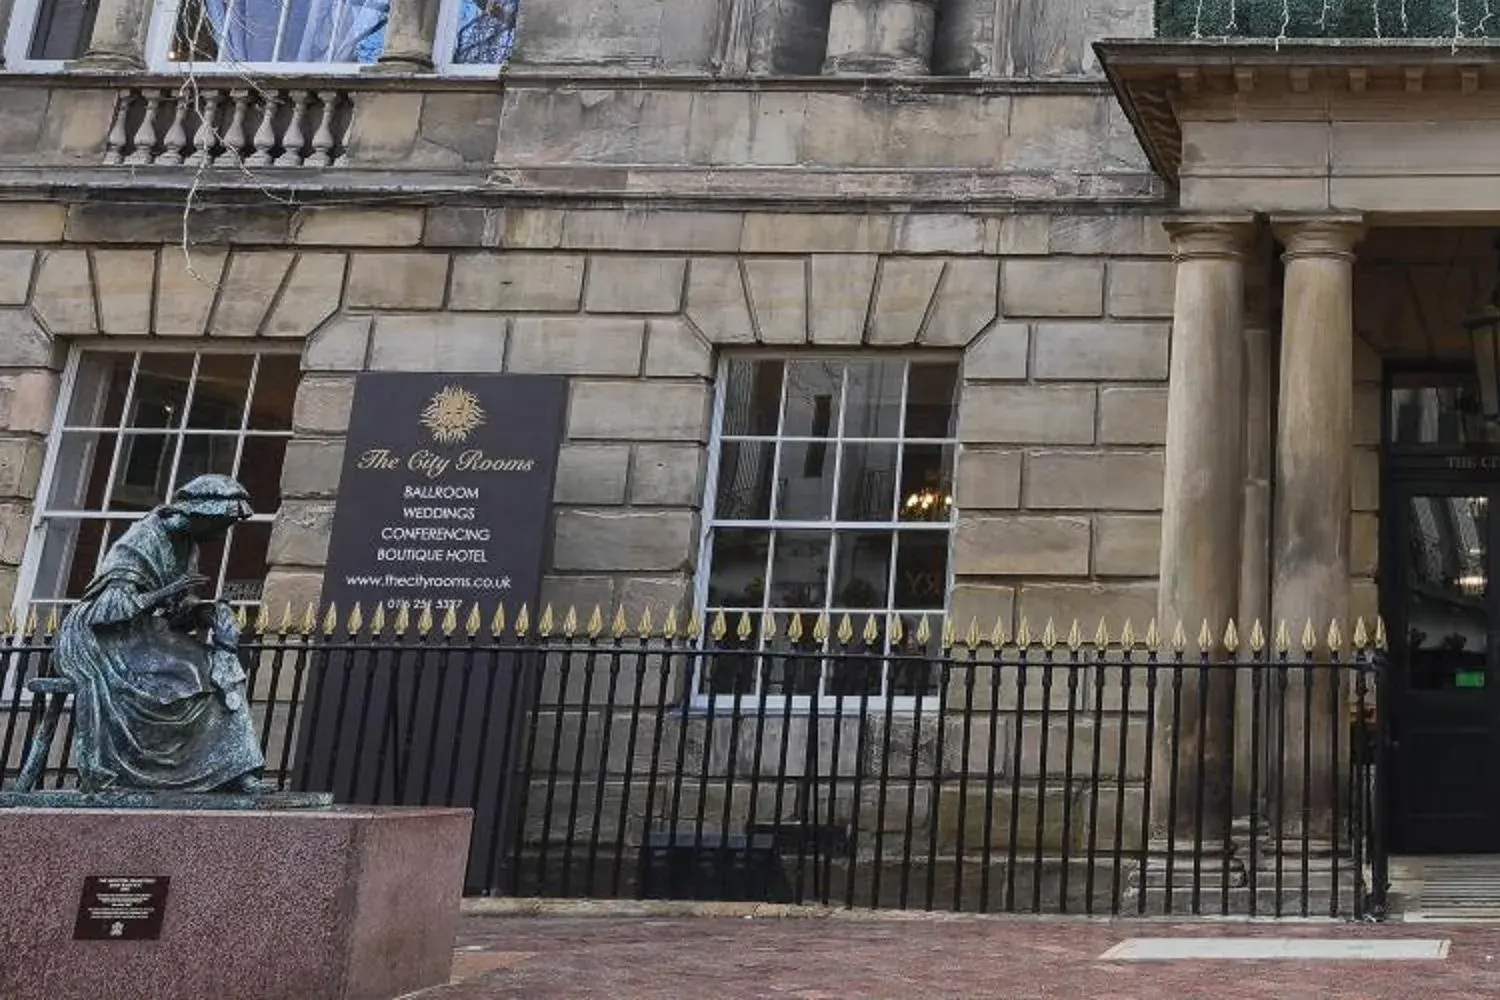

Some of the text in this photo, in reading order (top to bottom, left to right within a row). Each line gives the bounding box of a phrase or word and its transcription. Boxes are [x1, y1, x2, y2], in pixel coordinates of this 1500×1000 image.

[357, 449, 535, 478] The City Rooms
[403, 485, 479, 499] BALLROOM
[403, 507, 475, 520] WEDDINGS
[381, 527, 491, 541] CONFERENCING
[377, 548, 488, 563] BOUTIQUE HOTEL
[345, 573, 512, 589] www.thecityrooms.co.uk
